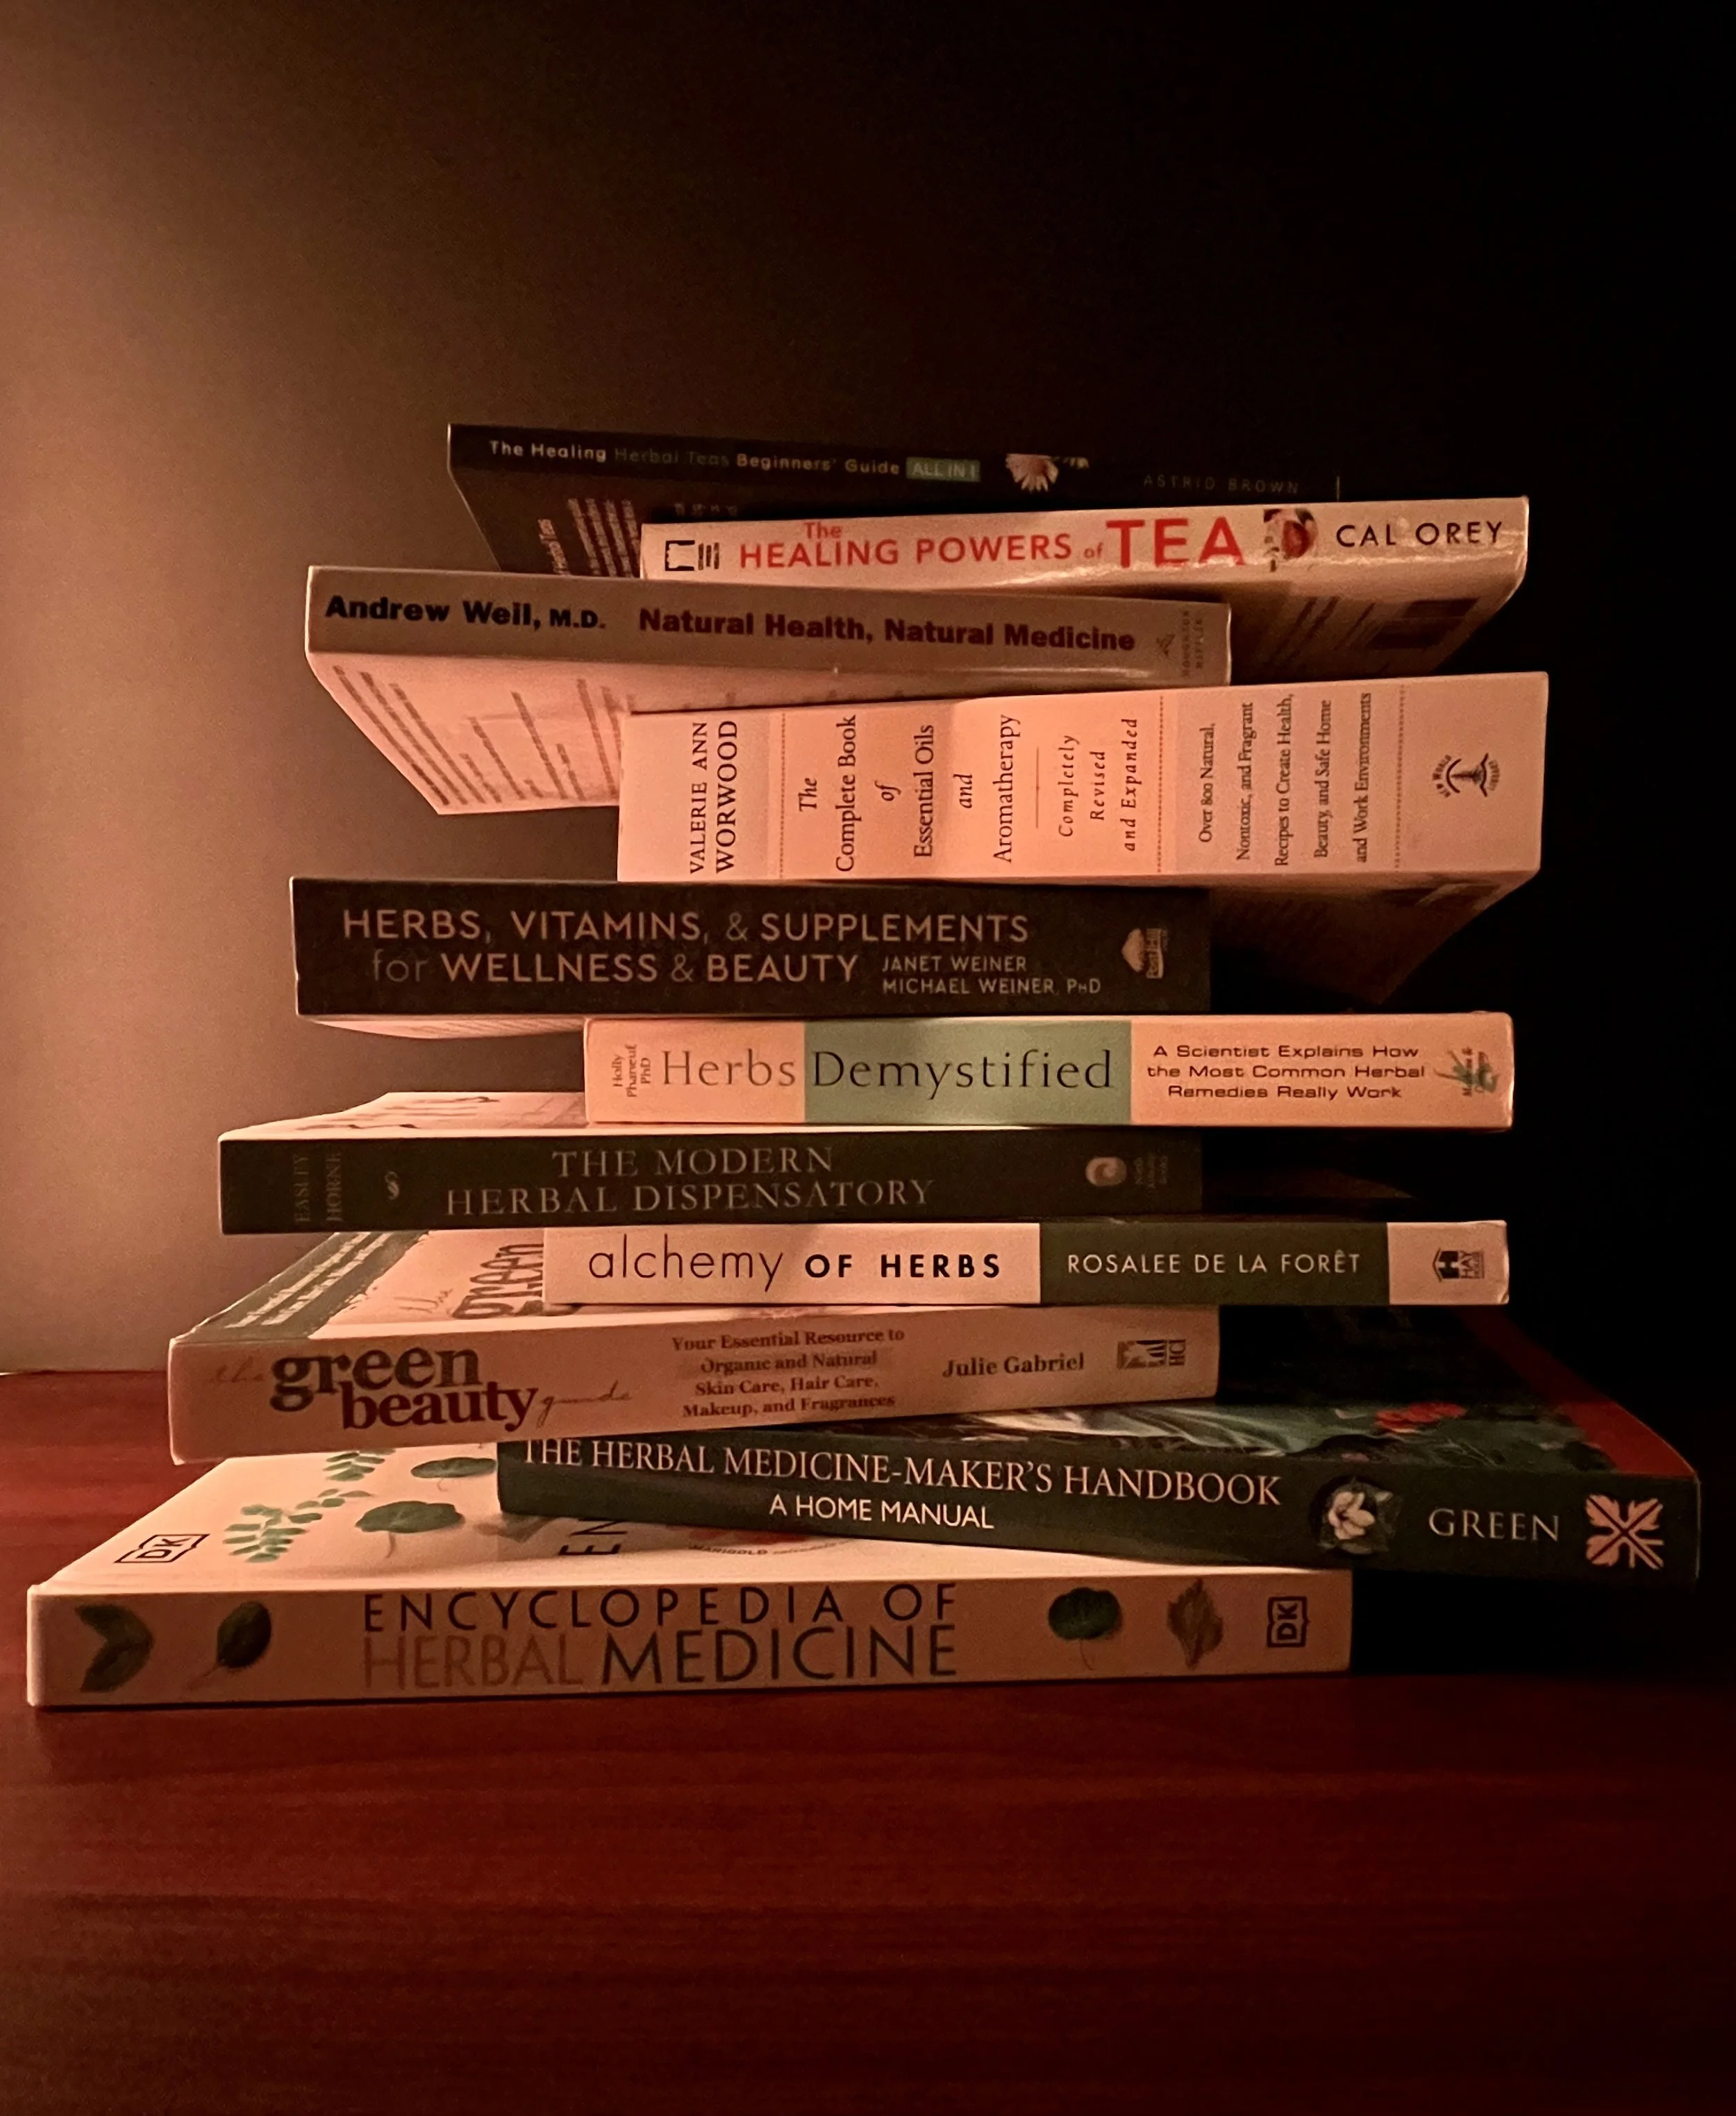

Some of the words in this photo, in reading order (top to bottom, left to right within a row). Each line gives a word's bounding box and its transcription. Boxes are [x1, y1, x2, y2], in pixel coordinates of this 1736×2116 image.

[489, 440, 524, 456] The
[531, 442, 606, 463] Healing
[615, 448, 678, 463] Herbal
[688, 452, 730, 467] Teas
[736, 453, 837, 472] Beginners'
[844, 458, 901, 476] Guide
[912, 462, 944, 477] ALL
[948, 463, 966, 478] IN
[1143, 473, 1215, 491] ASTRID
[1227, 474, 1299, 494] BROWN
[740, 540, 899, 569] HEALING
[916, 533, 1071, 564] POWERS
[1083, 545, 1104, 559] of
[1106, 515, 1247, 569] TEA
[804, 522, 842, 539] The
[1336, 524, 1396, 547] CAL
[1415, 522, 1502, 546] OREY
[325, 595, 449, 622] Andrew
[463, 601, 541, 630] Weil,
[550, 609, 605, 628] M.D.
[639, 608, 753, 635] Natural
[765, 613, 873, 644] Health,
[885, 619, 994, 645] Natural
[1004, 623, 1135, 651] Medicine
[1238, 703, 1257, 762] Fragrant
[1276, 694, 1294, 745] Health,
[1316, 700, 1331, 745] Home
[692, 722, 708, 771] ANN
[836, 715, 857, 768] Book
[915, 724, 934, 765] Oils
[1200, 724, 1215, 779] Natural,
[1355, 692, 1371, 791] Environments
[1121, 719, 1142, 809] Expanded
[1237, 766, 1253, 790] and
[1276, 749, 1290, 795] Create
[1315, 748, 1330, 778] Safe
[715, 720, 737, 874] WORWOOD
[798, 777, 817, 812] The
[875, 781, 901, 802] of
[953, 774, 973, 809] and
[992, 715, 1021, 863] Aromatherapy
[1058, 735, 1080, 837] Completely
[1090, 751, 1105, 821] Revised
[1200, 783, 1213, 807] 800
[1314, 781, 1329, 806] and
[835, 773, 862, 872] Complete
[914, 774, 934, 858] Essential
[1278, 797, 1290, 813] to
[1353, 794, 1369, 834] Work
[690, 783, 707, 874] VALERIE
[1120, 819, 1136, 851] and
[1199, 810, 1213, 843] Over
[1236, 793, 1253, 861] Nontoxic,
[1274, 816, 1294, 866] Recipes
[1314, 810, 1333, 858] Beauty,
[1353, 839, 1367, 863] and
[344, 909, 490, 944] HERBS,
[511, 911, 708, 944] VITAMINS,
[726, 913, 748, 941] &
[760, 913, 1028, 942] SUPPLEMENTS
[372, 949, 428, 983] for
[440, 953, 658, 983] WELLNESS
[671, 955, 694, 983] &
[708, 954, 859, 982] BEAUTY
[882, 956, 942, 972] JANET
[951, 956, 1026, 972] WEINER
[883, 978, 970, 994] MICHAEL
[1153, 1045, 1168, 1058] A
[1177, 1044, 1270, 1058] Scientist
[1278, 1044, 1364, 1060] Explains
[1372, 1045, 1419, 1058] How
[612, 1055, 625, 1087] Holly
[640, 1058, 651, 1084] PhD
[662, 1049, 795, 1088] Herbs
[812, 1049, 1112, 1101] Demystified
[1147, 1065, 1180, 1078] the
[1189, 1065, 1244, 1078] Most
[1253, 1065, 1346, 1078] Common
[1355, 1065, 1425, 1078] Herbal
[1168, 1085, 1268, 1098] Remedies
[1277, 1085, 1338, 1101] Really
[1346, 1085, 1401, 1098] Work
[553, 1149, 637, 1178] THE
[656, 1146, 833, 1176] MODERN
[447, 1186, 619, 1215] HERBAL
[633, 1180, 935, 1213] DISPENSATORY
[589, 1233, 783, 1292] alchemy
[805, 1254, 851, 1278] OF
[881, 1253, 1000, 1278] HERBS
[1068, 1253, 1180, 1274] ROSALEE
[1195, 1254, 1225, 1274] DE
[1239, 1254, 1267, 1274] LA
[1282, 1249, 1360, 1274] FORÊT
[672, 1335, 716, 1351] Your
[721, 1330, 799, 1349] Essential
[805, 1329, 884, 1345] Resource
[887, 1328, 905, 1341] to
[1169, 1339, 1186, 1366] HCI
[270, 1347, 482, 1412] green
[701, 1357, 770, 1375] Organic
[776, 1354, 806, 1369] and
[812, 1350, 877, 1368] Natural
[943, 1356, 997, 1378] Julie
[1004, 1351, 1084, 1374] Gabriel
[695, 1380, 734, 1396] Skin
[739, 1378, 785, 1394] Care,
[791, 1375, 830, 1392] Hair
[341, 1381, 539, 1431] beauty
[683, 1400, 758, 1418] Makeup,
[764, 1398, 794, 1413] and
[801, 1395, 895, 1411] Fragrances
[592, 1440, 715, 1474] HERBAL
[725, 1447, 1052, 1493] MEDICINE-MAKER'S
[1065, 1465, 1282, 1506] HANDBOOK
[769, 1494, 787, 1515] A
[796, 1497, 873, 1522] HOME
[881, 1500, 994, 1529] MANUAL
[1429, 1508, 1560, 1542] GREEN
[136, 1537, 192, 1559] DK
[365, 1584, 844, 1632] ENCYCLOPEDIA
[884, 1583, 956, 1622] OF
[1276, 1603, 1298, 1640] DK
[364, 1630, 583, 1690] HERBAL
[601, 1623, 956, 1685] MEDICINE
